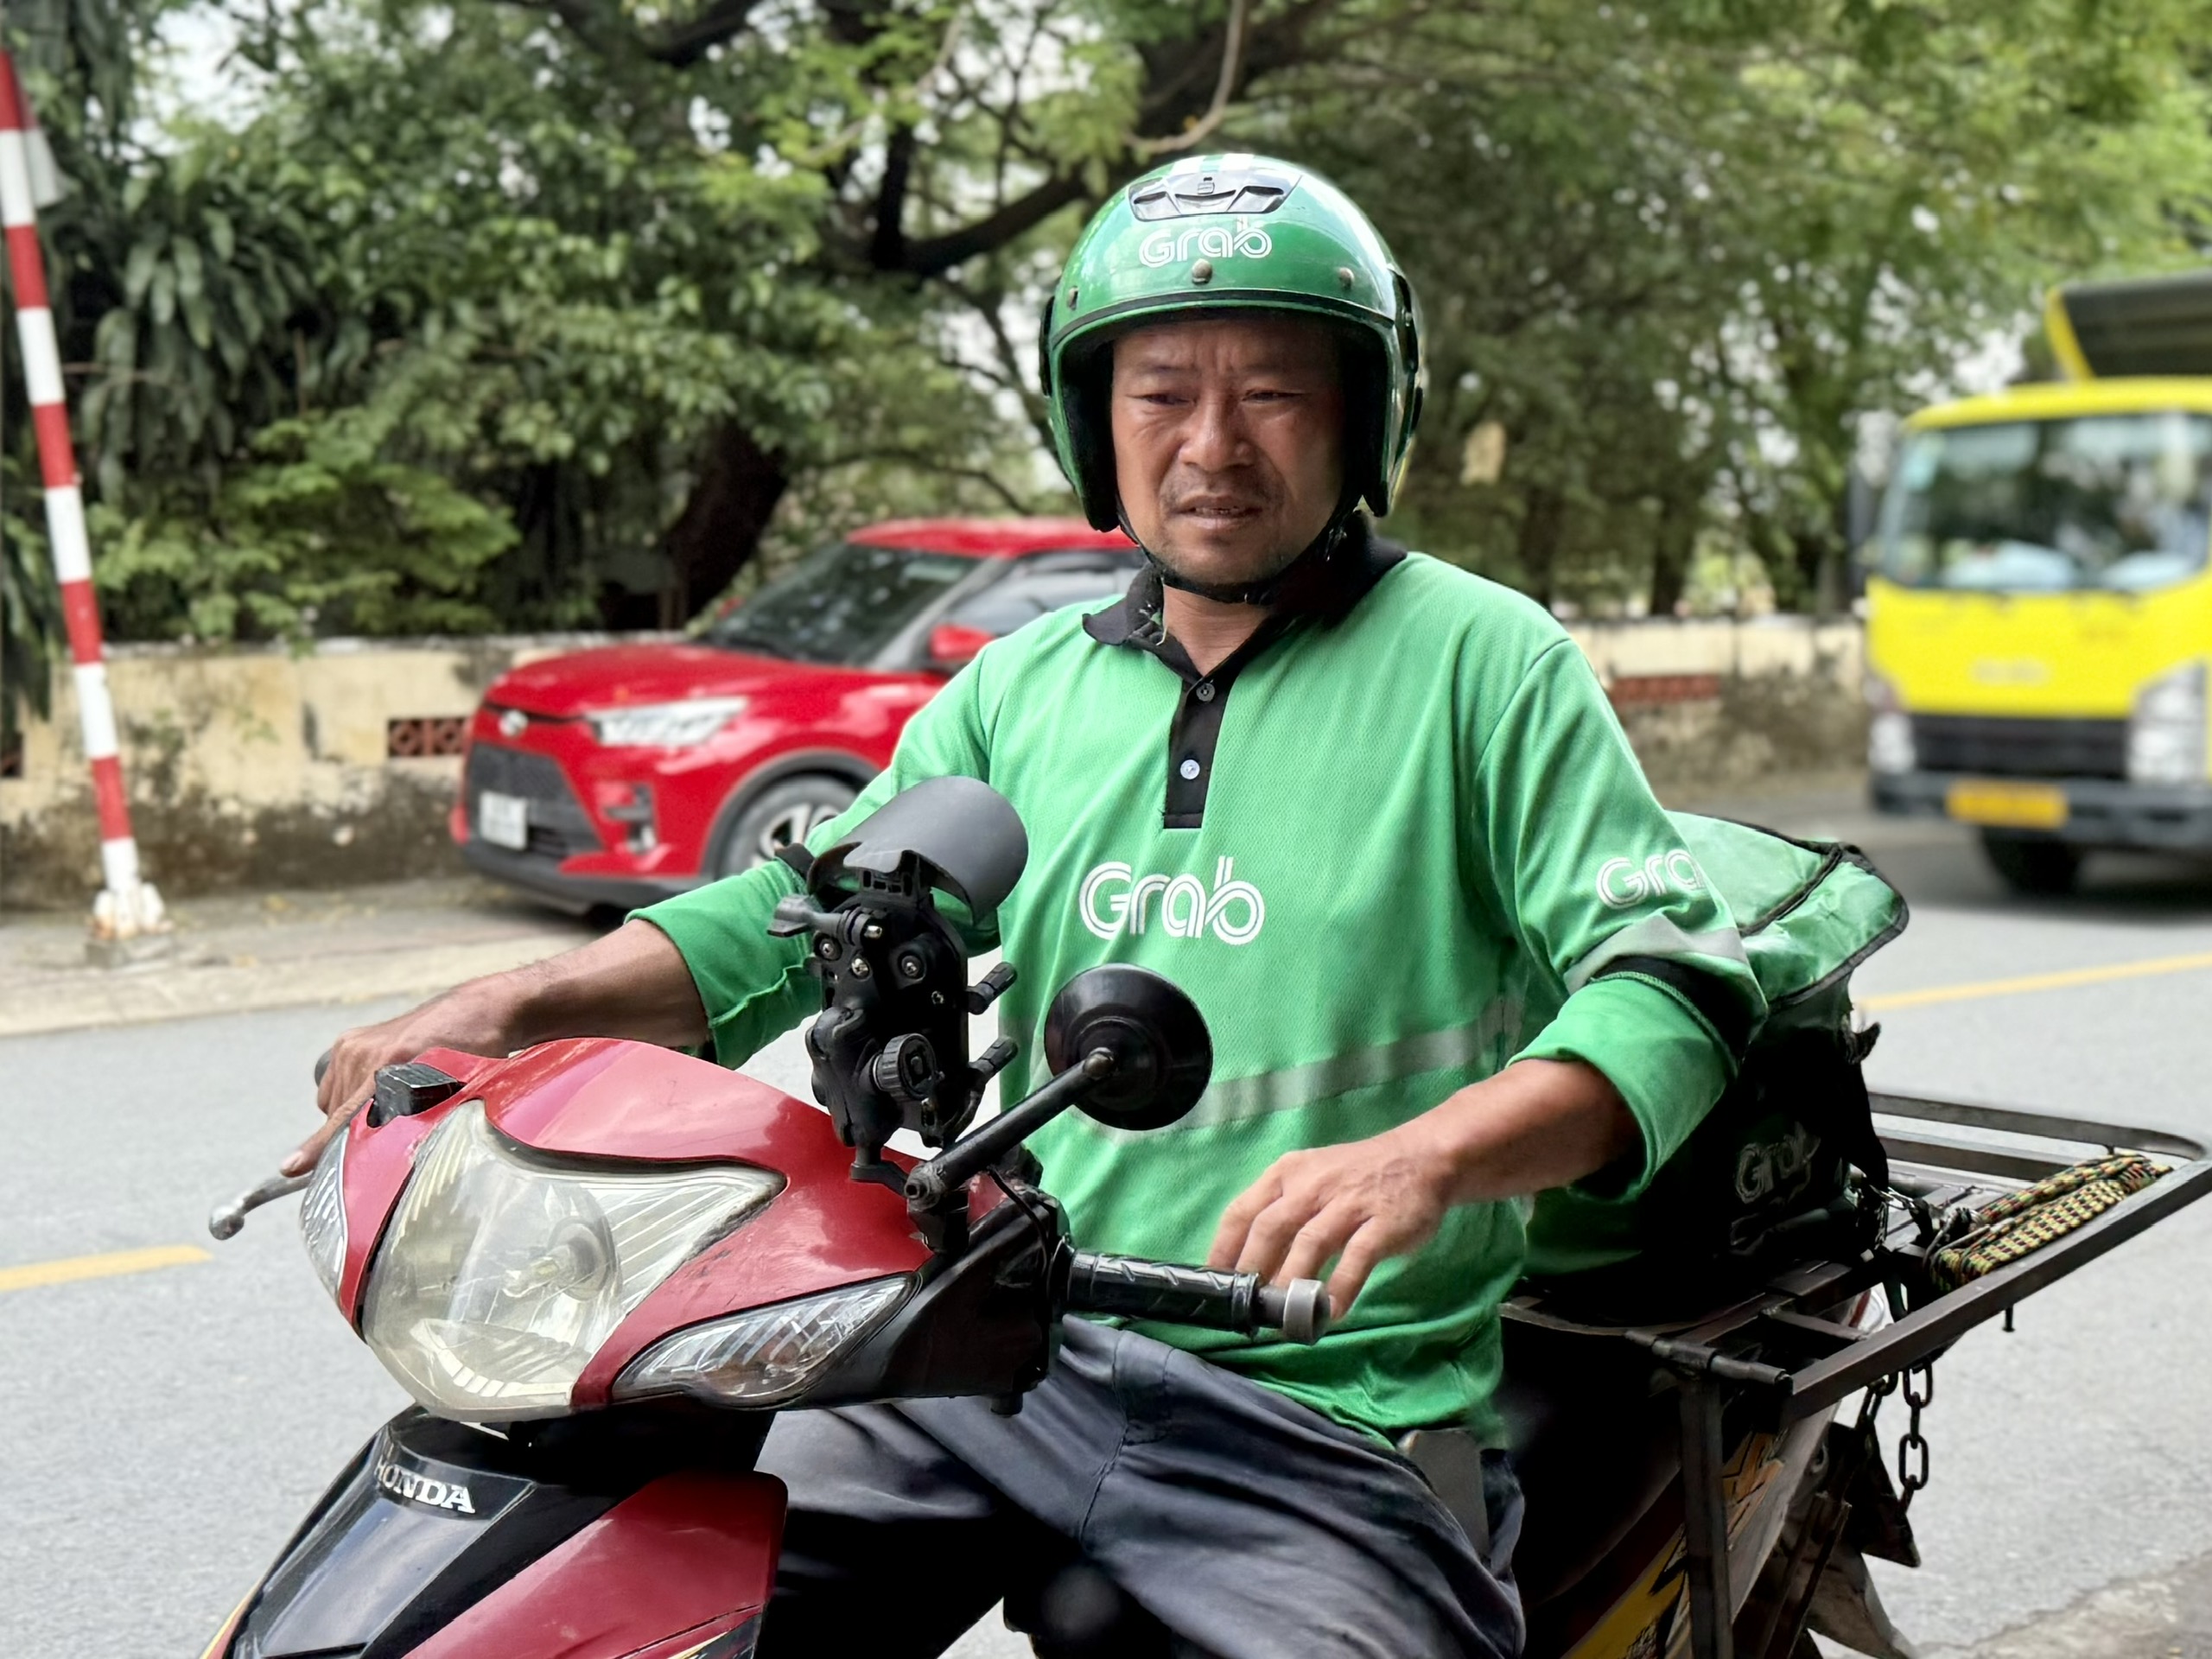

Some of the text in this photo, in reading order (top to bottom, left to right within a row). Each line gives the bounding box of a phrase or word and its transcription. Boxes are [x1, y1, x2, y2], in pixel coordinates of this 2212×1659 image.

[1139, 216, 1273, 268] Grab
[1079, 855, 1265, 945] Grab
[1596, 849, 1707, 908] Gra
[374, 1455, 475, 1514] HONDA
